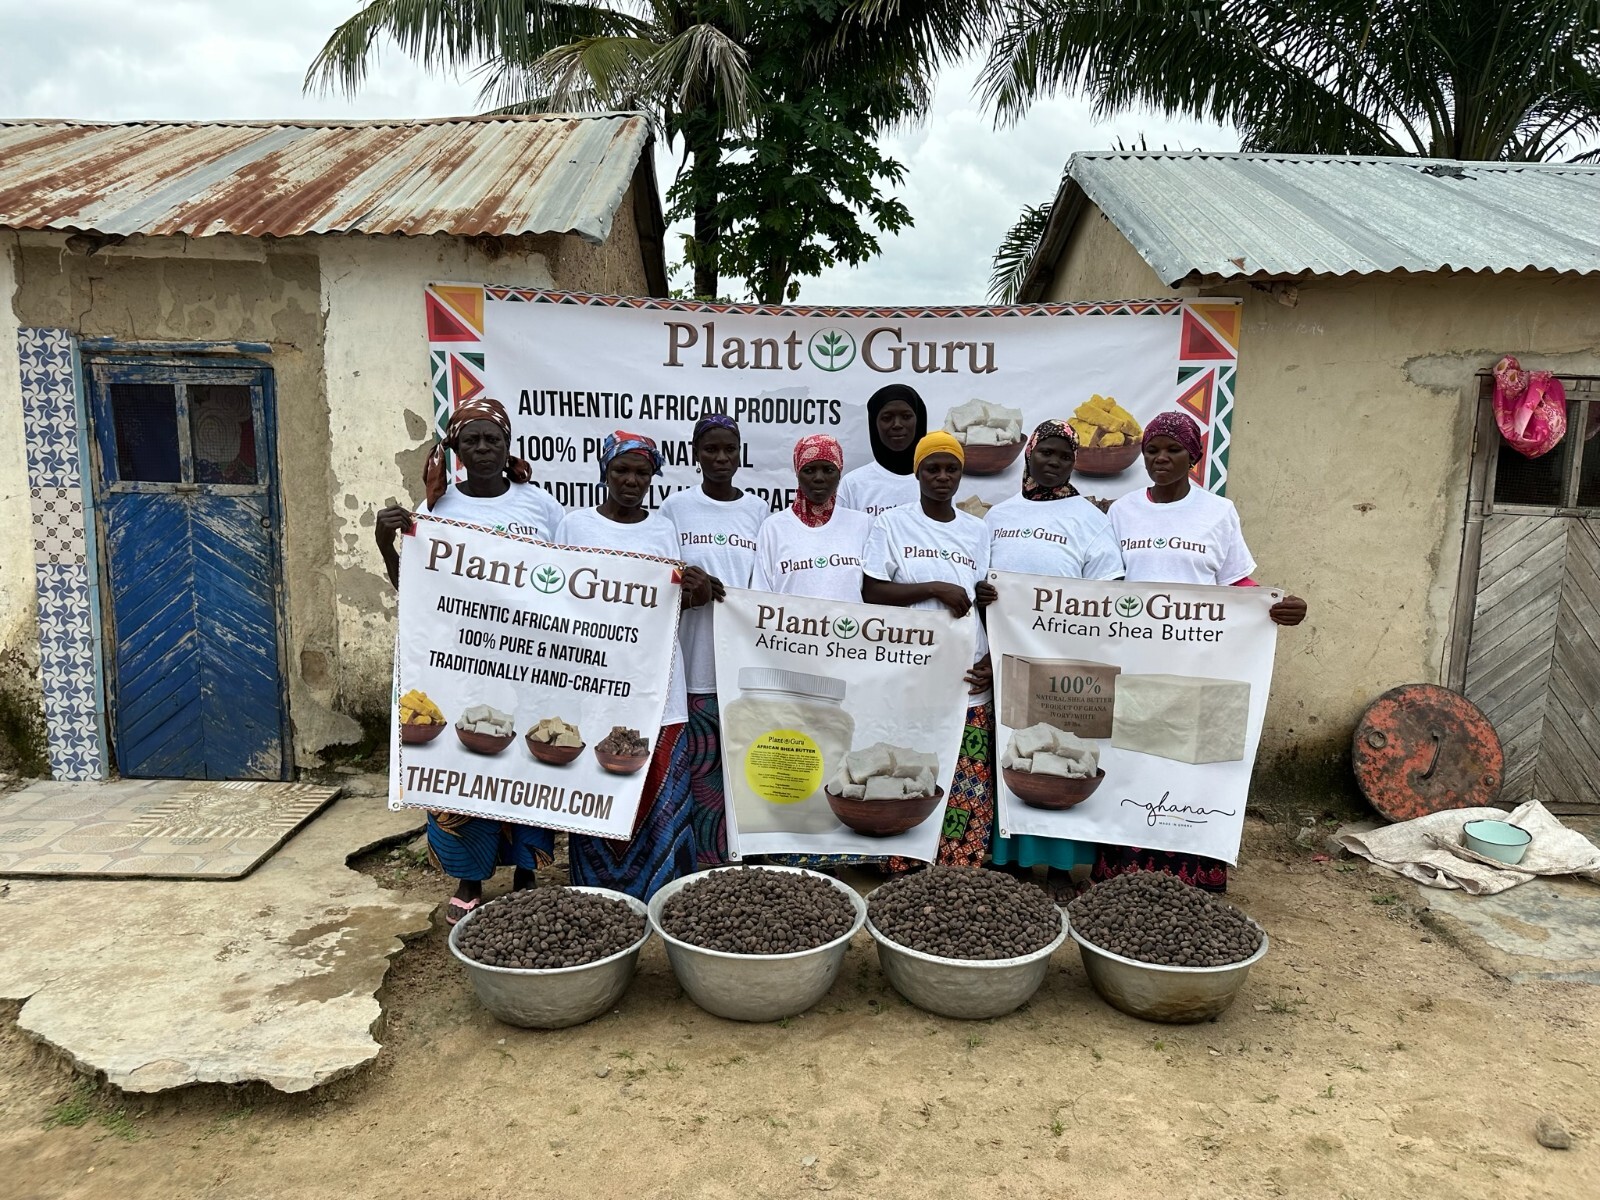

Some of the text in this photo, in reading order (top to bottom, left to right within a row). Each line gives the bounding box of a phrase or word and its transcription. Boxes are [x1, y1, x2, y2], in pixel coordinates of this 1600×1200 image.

[663, 321, 999, 374] Plant Guru
[518, 389, 842, 425] AUTHENTIC AFRICAN PRODUCTS
[516, 435, 577, 463] 100%
[681, 532, 713, 546] Plant
[994, 527, 1068, 545] Plant Guru
[1120, 536, 1206, 554] Plant Guru
[780, 553, 860, 575] Plant Guru
[904, 546, 939, 559] Plant
[424, 538, 658, 609] Plant Guru
[437, 595, 639, 644] AUTHENTIC AFRICAN PRODUCTS
[1032, 587, 1226, 622] Plant Guru
[755, 604, 935, 647] Plant Guru
[1032, 615, 1223, 643] African Shea Butter
[458, 628, 608, 668] 100% PURE & NATURAL
[755, 633, 932, 665] African Shea Butter
[429, 650, 631, 698] TRADITIONALLY HAND-CRAFTED
[1048, 675, 1102, 695] 100%
[1036, 693, 1112, 704] NATURAL SHEA BUTTER
[1040, 702, 1072, 711] PRODUCT
[406, 766, 614, 820] THEPLANTGURU.COM
[1121, 790, 1236, 827] ghana
